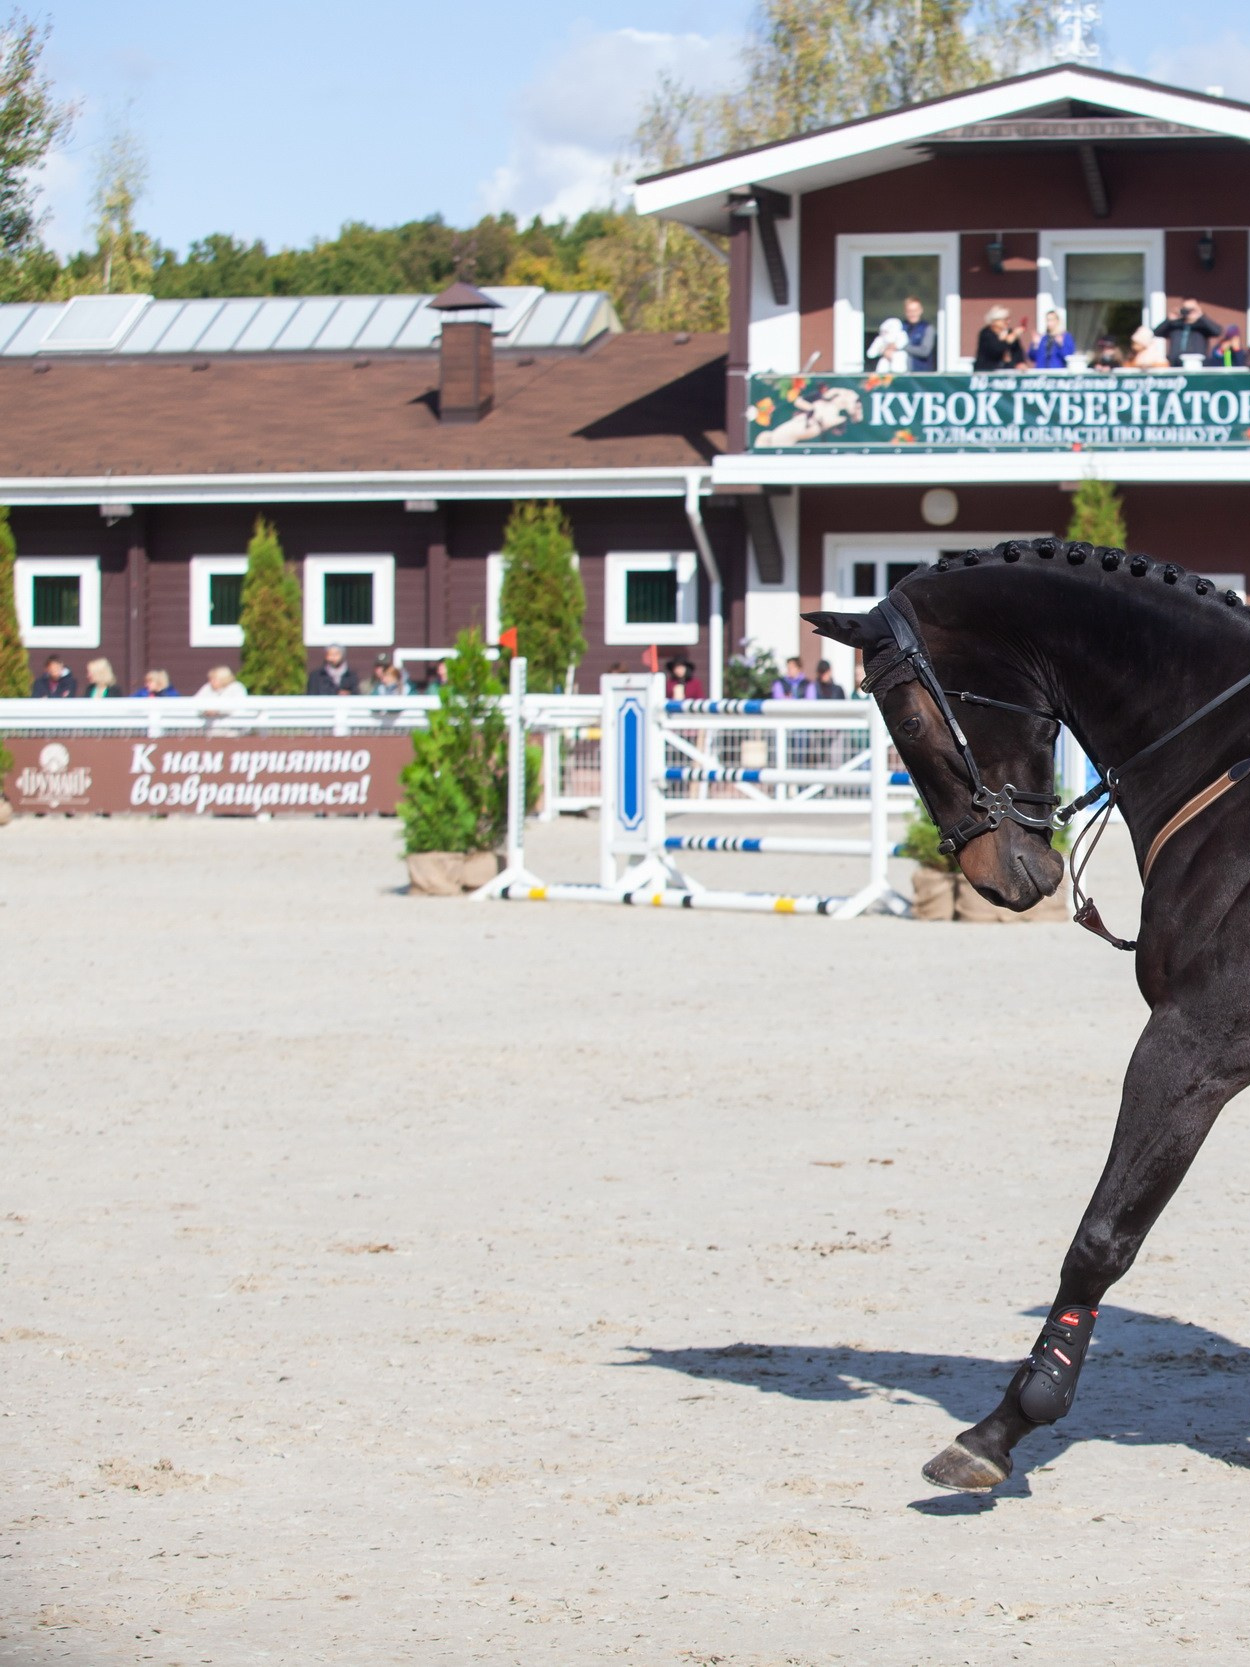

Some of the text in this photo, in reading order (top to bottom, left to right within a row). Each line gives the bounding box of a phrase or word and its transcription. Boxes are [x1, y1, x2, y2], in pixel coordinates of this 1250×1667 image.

[869, 390, 1003, 426] КУБОК
[924, 426, 1232, 444] ТУЛЬСКОЙ ОБЛАСТИ ПО КОНКУРУ
[131, 744, 371, 781] К нам приятно
[131, 775, 371, 813] возвращаться!
